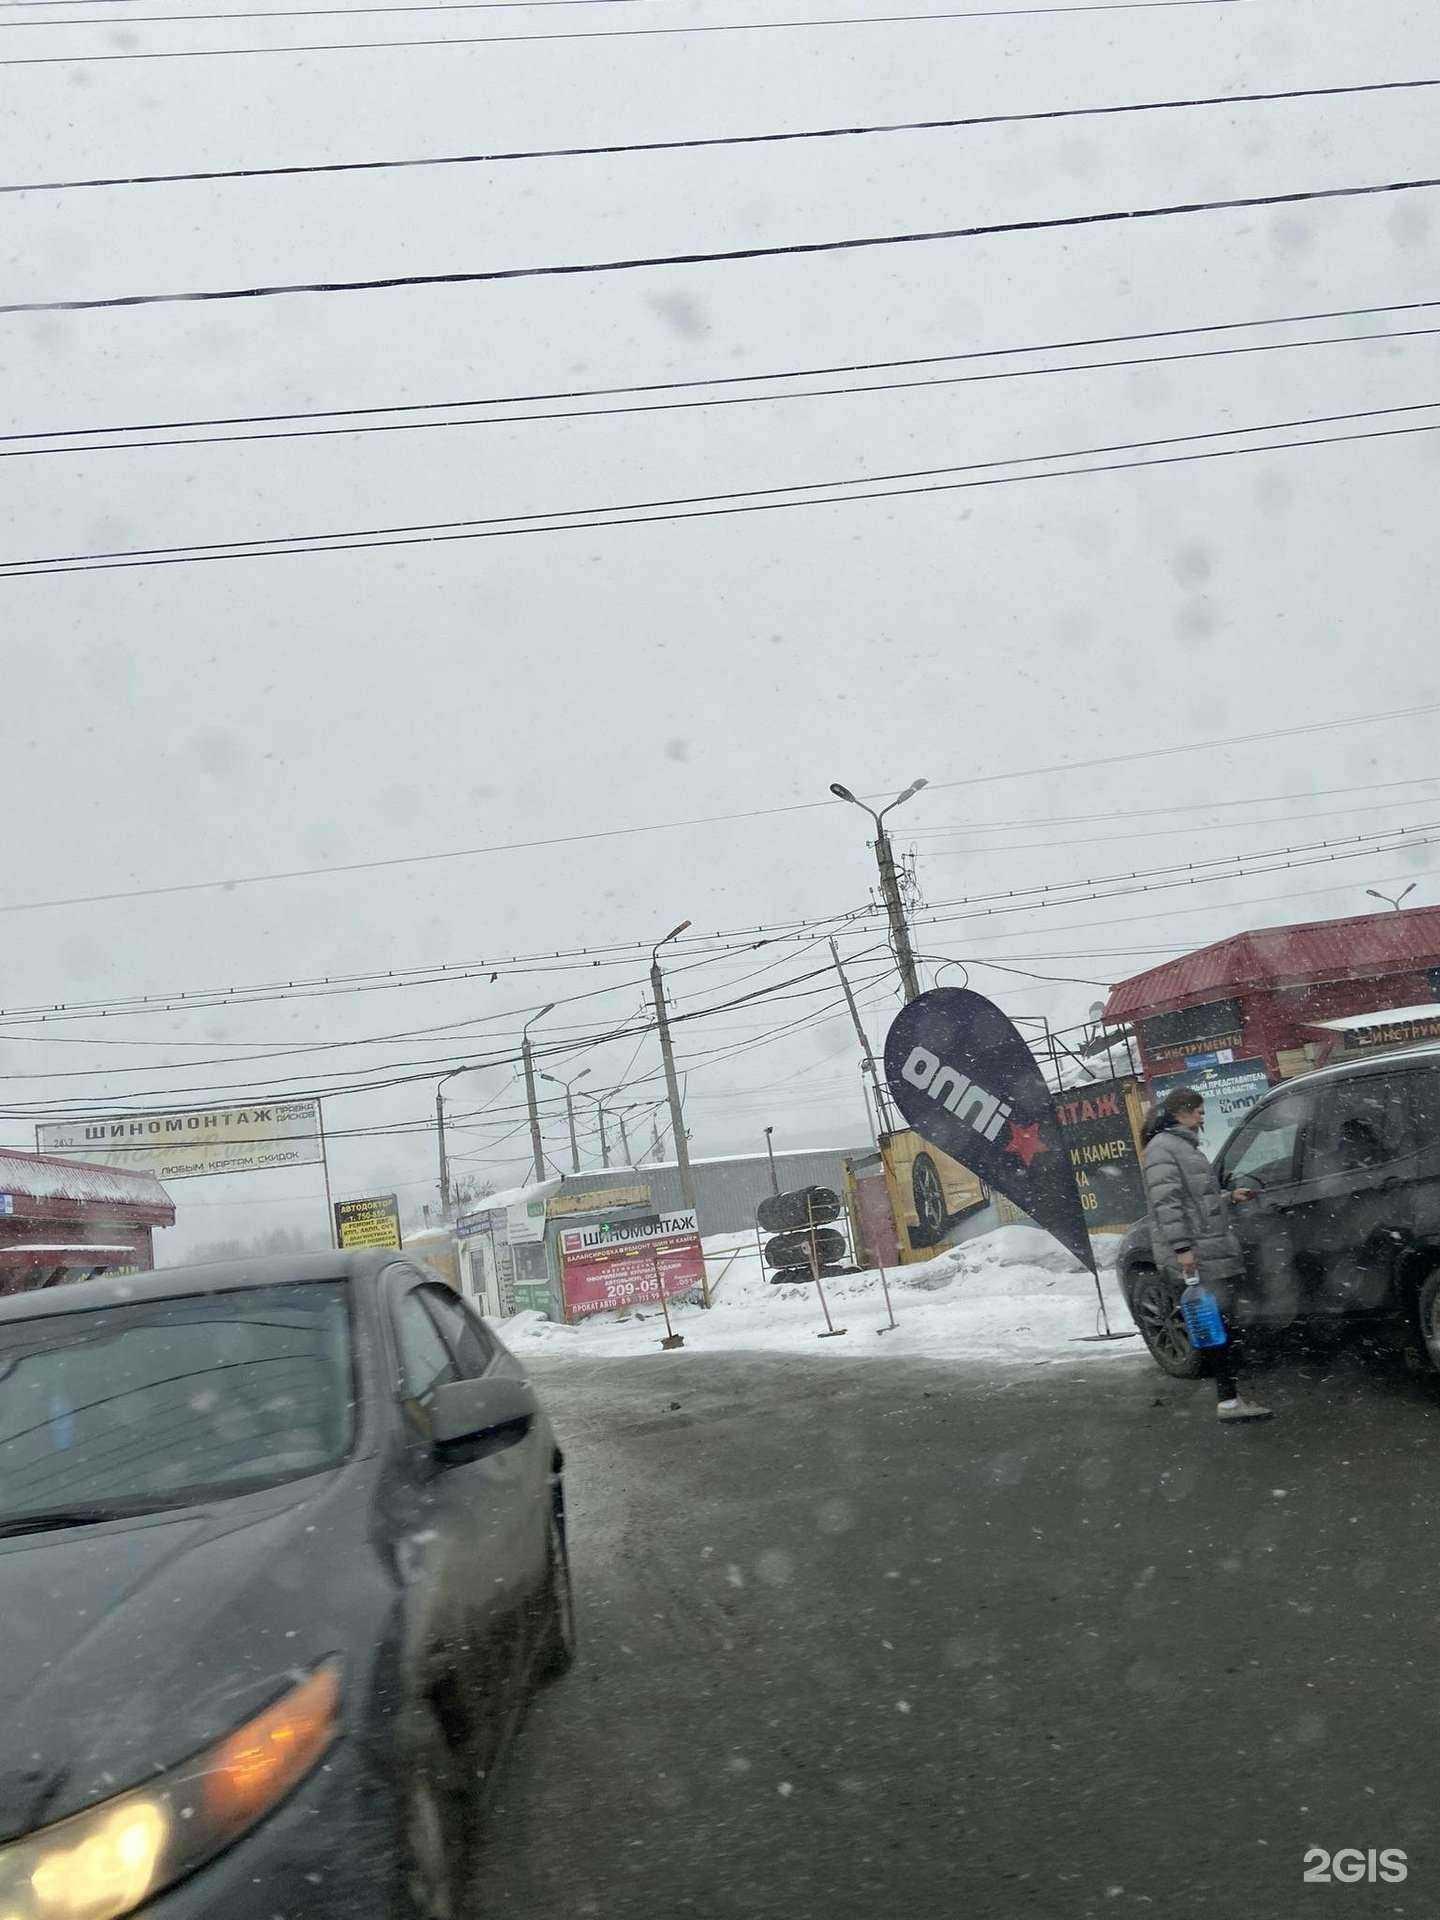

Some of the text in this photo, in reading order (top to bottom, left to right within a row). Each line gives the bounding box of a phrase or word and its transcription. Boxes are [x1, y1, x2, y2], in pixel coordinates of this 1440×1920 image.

[1163, 1035, 1244, 1059] ИНСТРУМЕНТЫ
[85, 1109, 272, 1140] ШИНОМОНТАЖ
[161, 1163, 204, 1176] ЛЮБЫМ
[208, 1157, 254, 1169] КАРТАМ
[258, 1151, 300, 1164] СКИДОК
[1083, 1140, 1126, 1164] КАМЕР
[583, 1215, 695, 1247] ШИНОМОНТАЖ
[607, 1278, 665, 1298] 209-051
